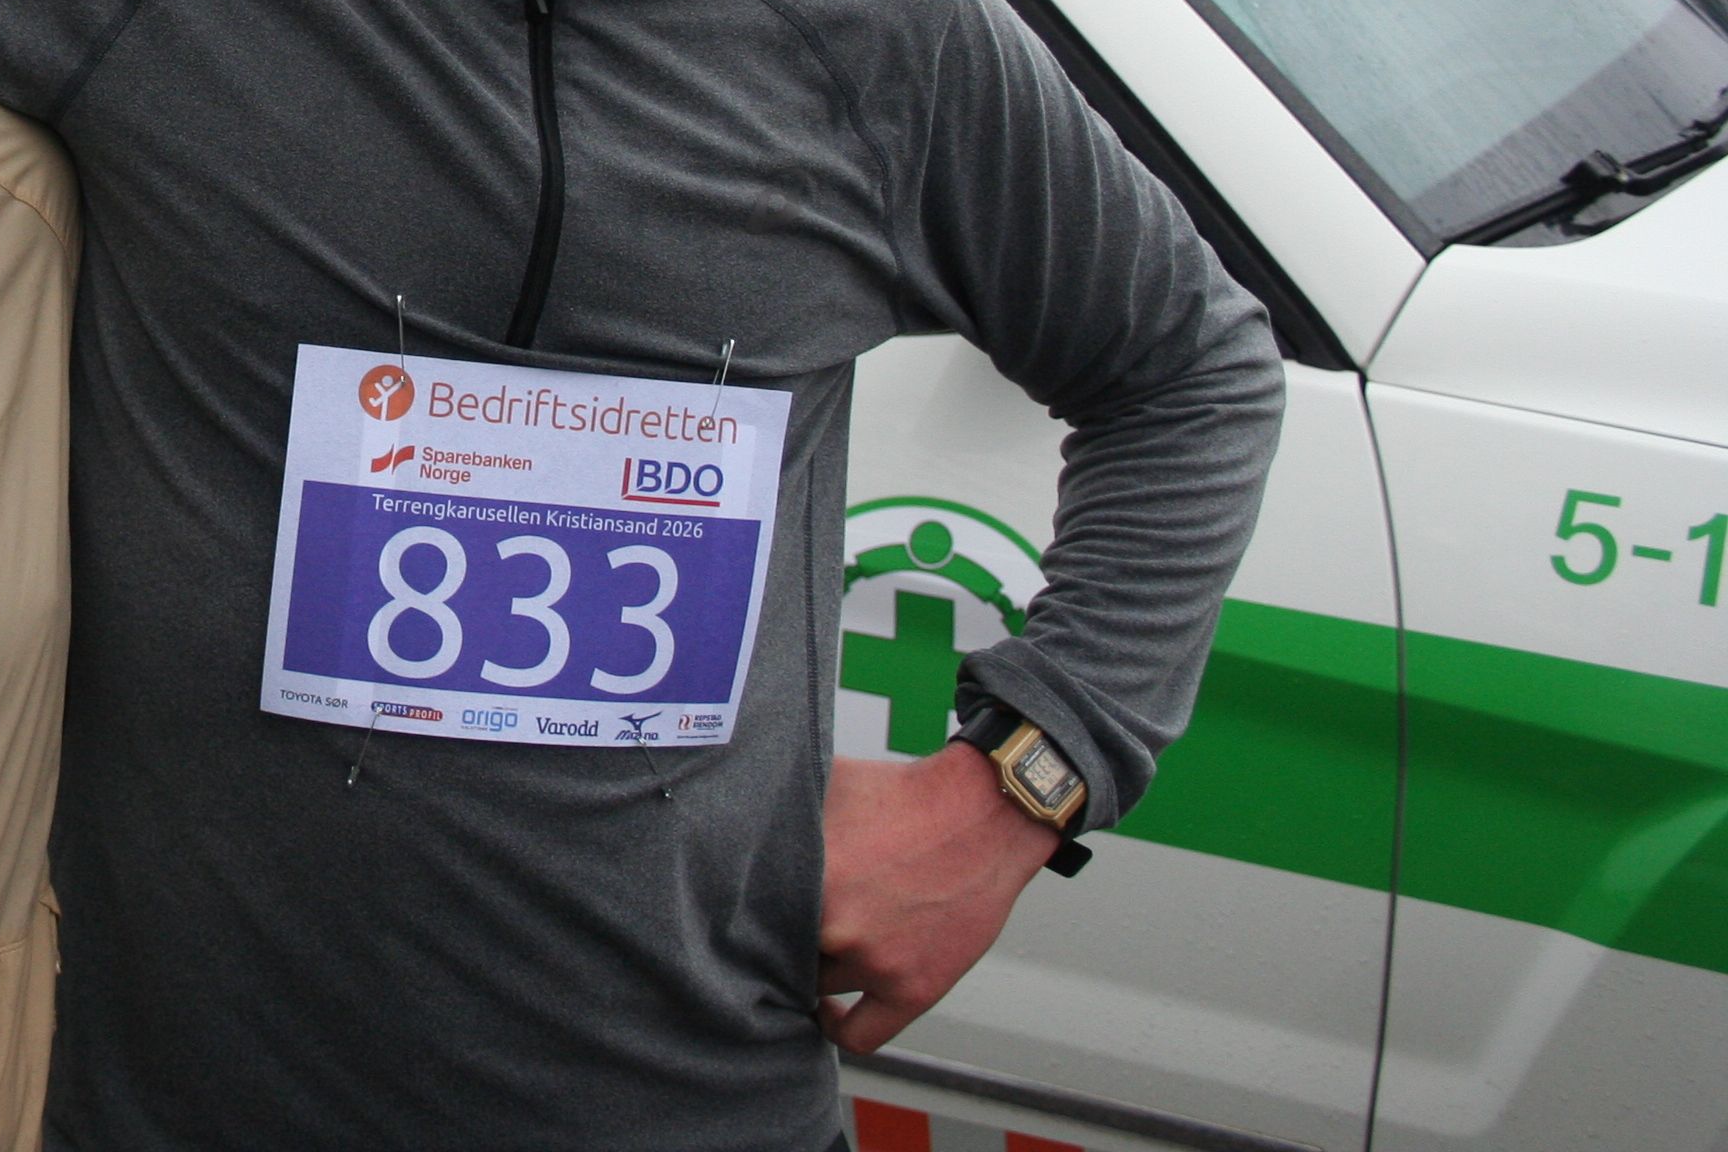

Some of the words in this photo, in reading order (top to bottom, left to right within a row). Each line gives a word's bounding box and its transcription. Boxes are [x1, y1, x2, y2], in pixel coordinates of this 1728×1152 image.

[428, 381, 738, 444] Bedriftsidretten
[421, 446, 533, 471] Sparebanken
[418, 463, 472, 484] Norge
[635, 458, 725, 497] BDO
[372, 493, 540, 525] Terrengkarusellen
[545, 509, 658, 537] Kristiansand
[662, 520, 704, 539] 2026
[1550, 487, 1728, 608] 5-1
[367, 525, 679, 695] 833
[280, 689, 323, 705] TOYOTA
[325, 696, 349, 709] SØR
[409, 708, 442, 721] PROFIL
[462, 708, 518, 732] origo
[536, 717, 599, 737] Varodd
